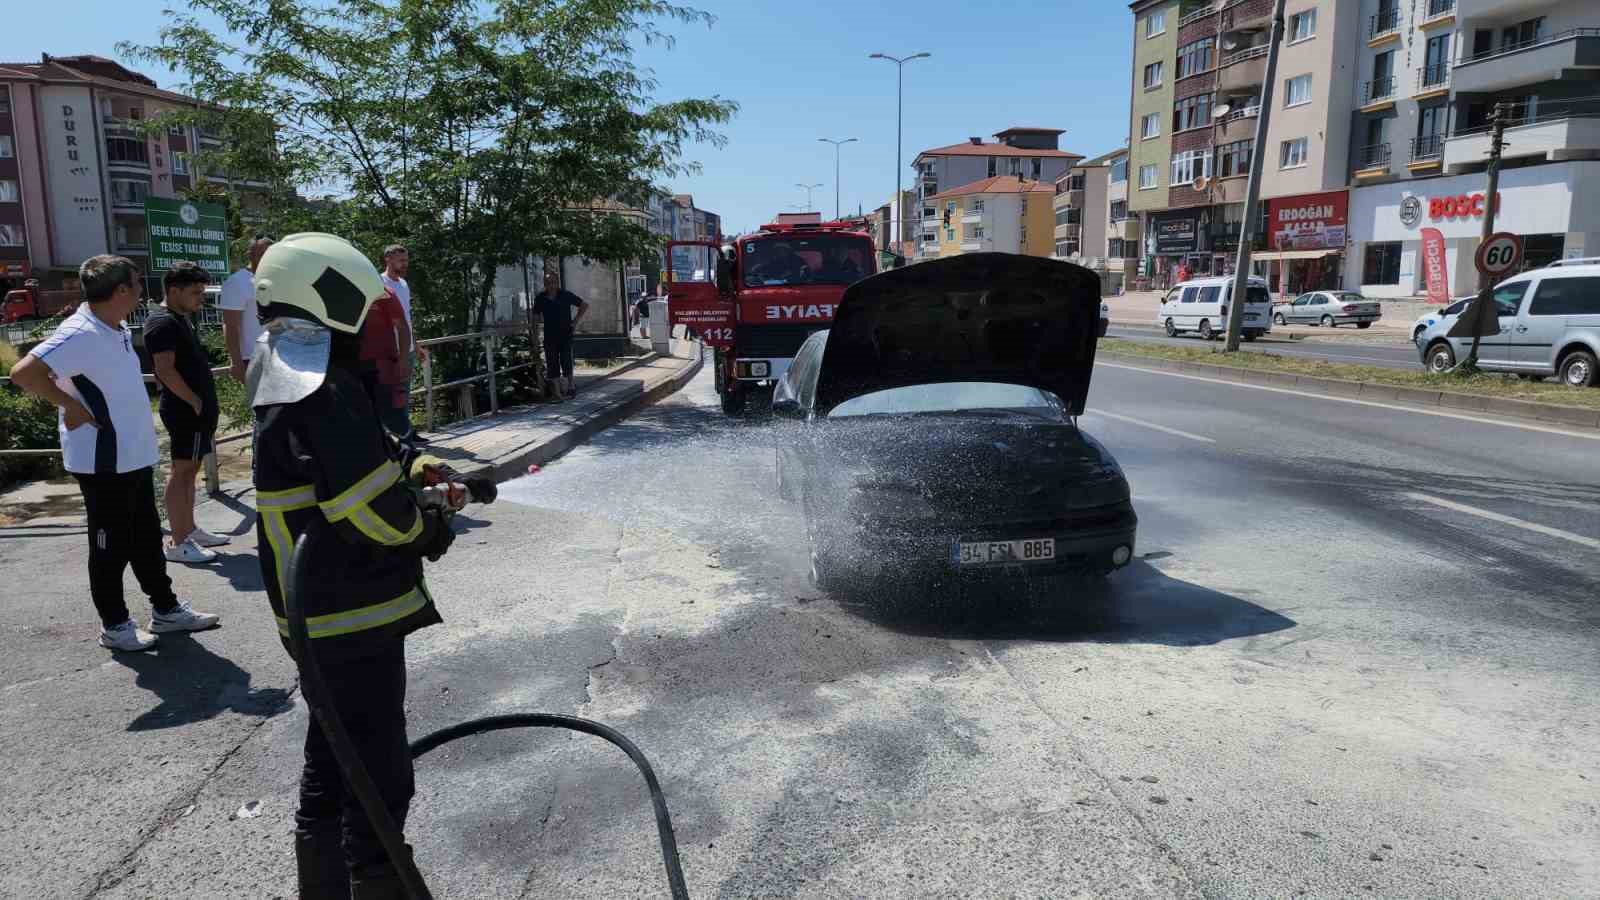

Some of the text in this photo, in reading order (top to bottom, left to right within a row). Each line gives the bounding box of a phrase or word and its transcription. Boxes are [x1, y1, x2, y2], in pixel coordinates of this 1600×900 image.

[62, 104, 78, 161] DURU
[1278, 204, 1334, 221] ERDOĞAN
[747, 243, 754, 253] 5
[1487, 246, 1513, 265] 60
[704, 328, 733, 340] 112
[962, 544, 981, 561] 34
[1024, 540, 1051, 558] 885
